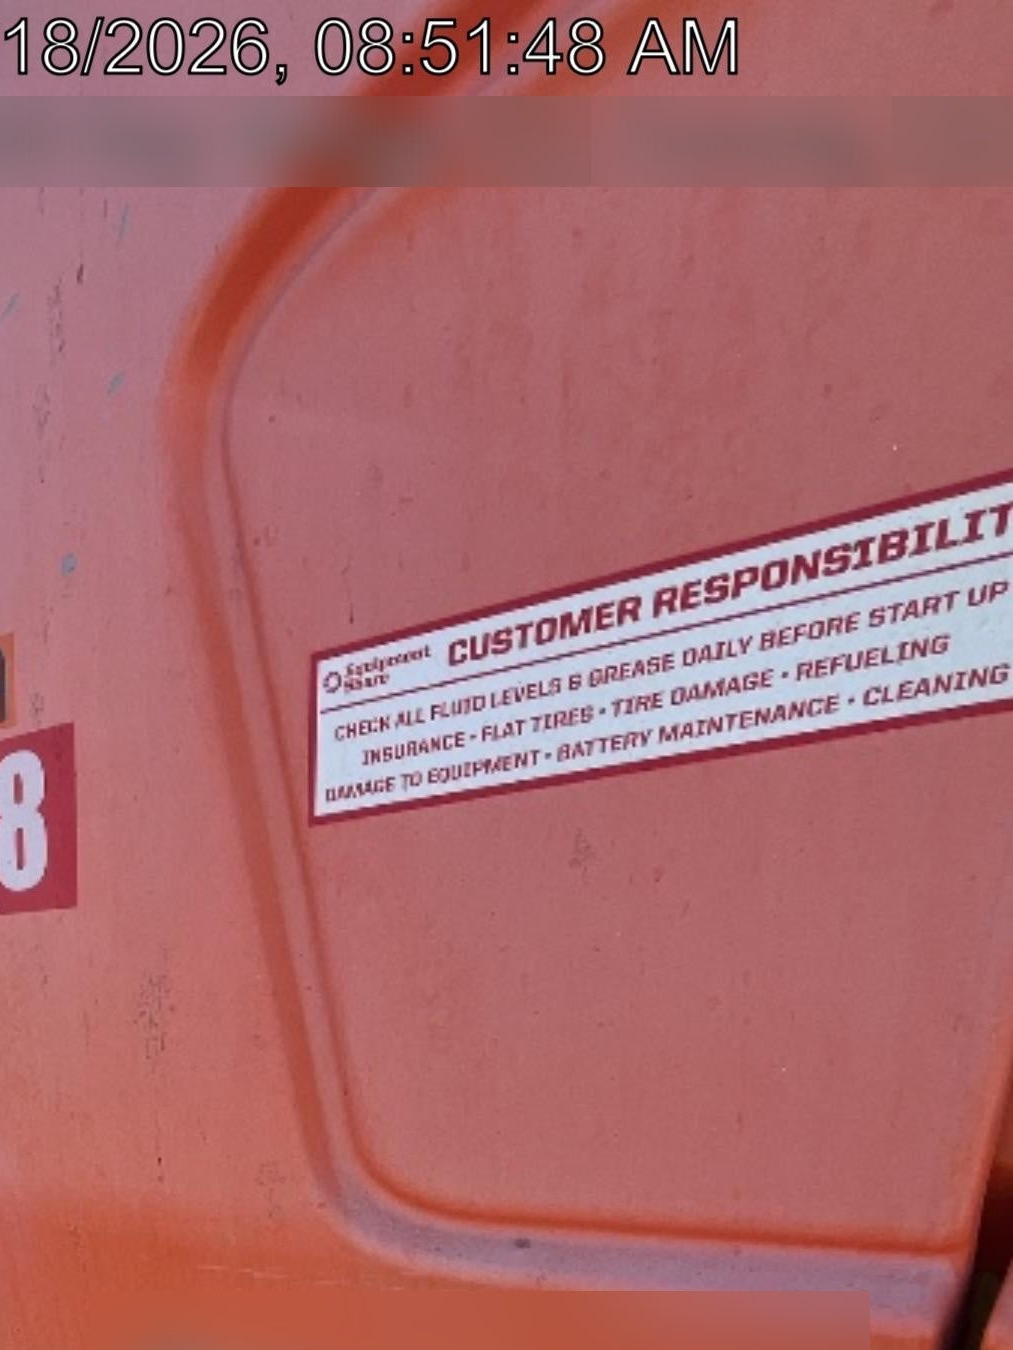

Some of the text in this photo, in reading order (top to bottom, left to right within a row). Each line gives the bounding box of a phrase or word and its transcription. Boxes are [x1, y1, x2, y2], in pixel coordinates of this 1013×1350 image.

[334, 714, 390, 742] CHECK
[395, 706, 426, 729] ALL
[430, 695, 487, 722] FLUID
[491, 678, 562, 710] LEVELS
[588, 653, 676, 687] GREASE
[682, 634, 754, 668] DAILY
[759, 611, 862, 652] BEFORE
[868, 590, 961, 629] START
[967, 580, 1010, 608] UP
[345, 645, 431, 678] Equipment
[448, 597, 641, 667] CUSTOMER
[325, 662, 1012, 803] DAMAGE TO EQUIPMENT BATTERY MAINTENANCE CLEANING
[361, 633, 952, 767] INSURANCE FLAT TIRES TIRE DAMAGE REFUELING
